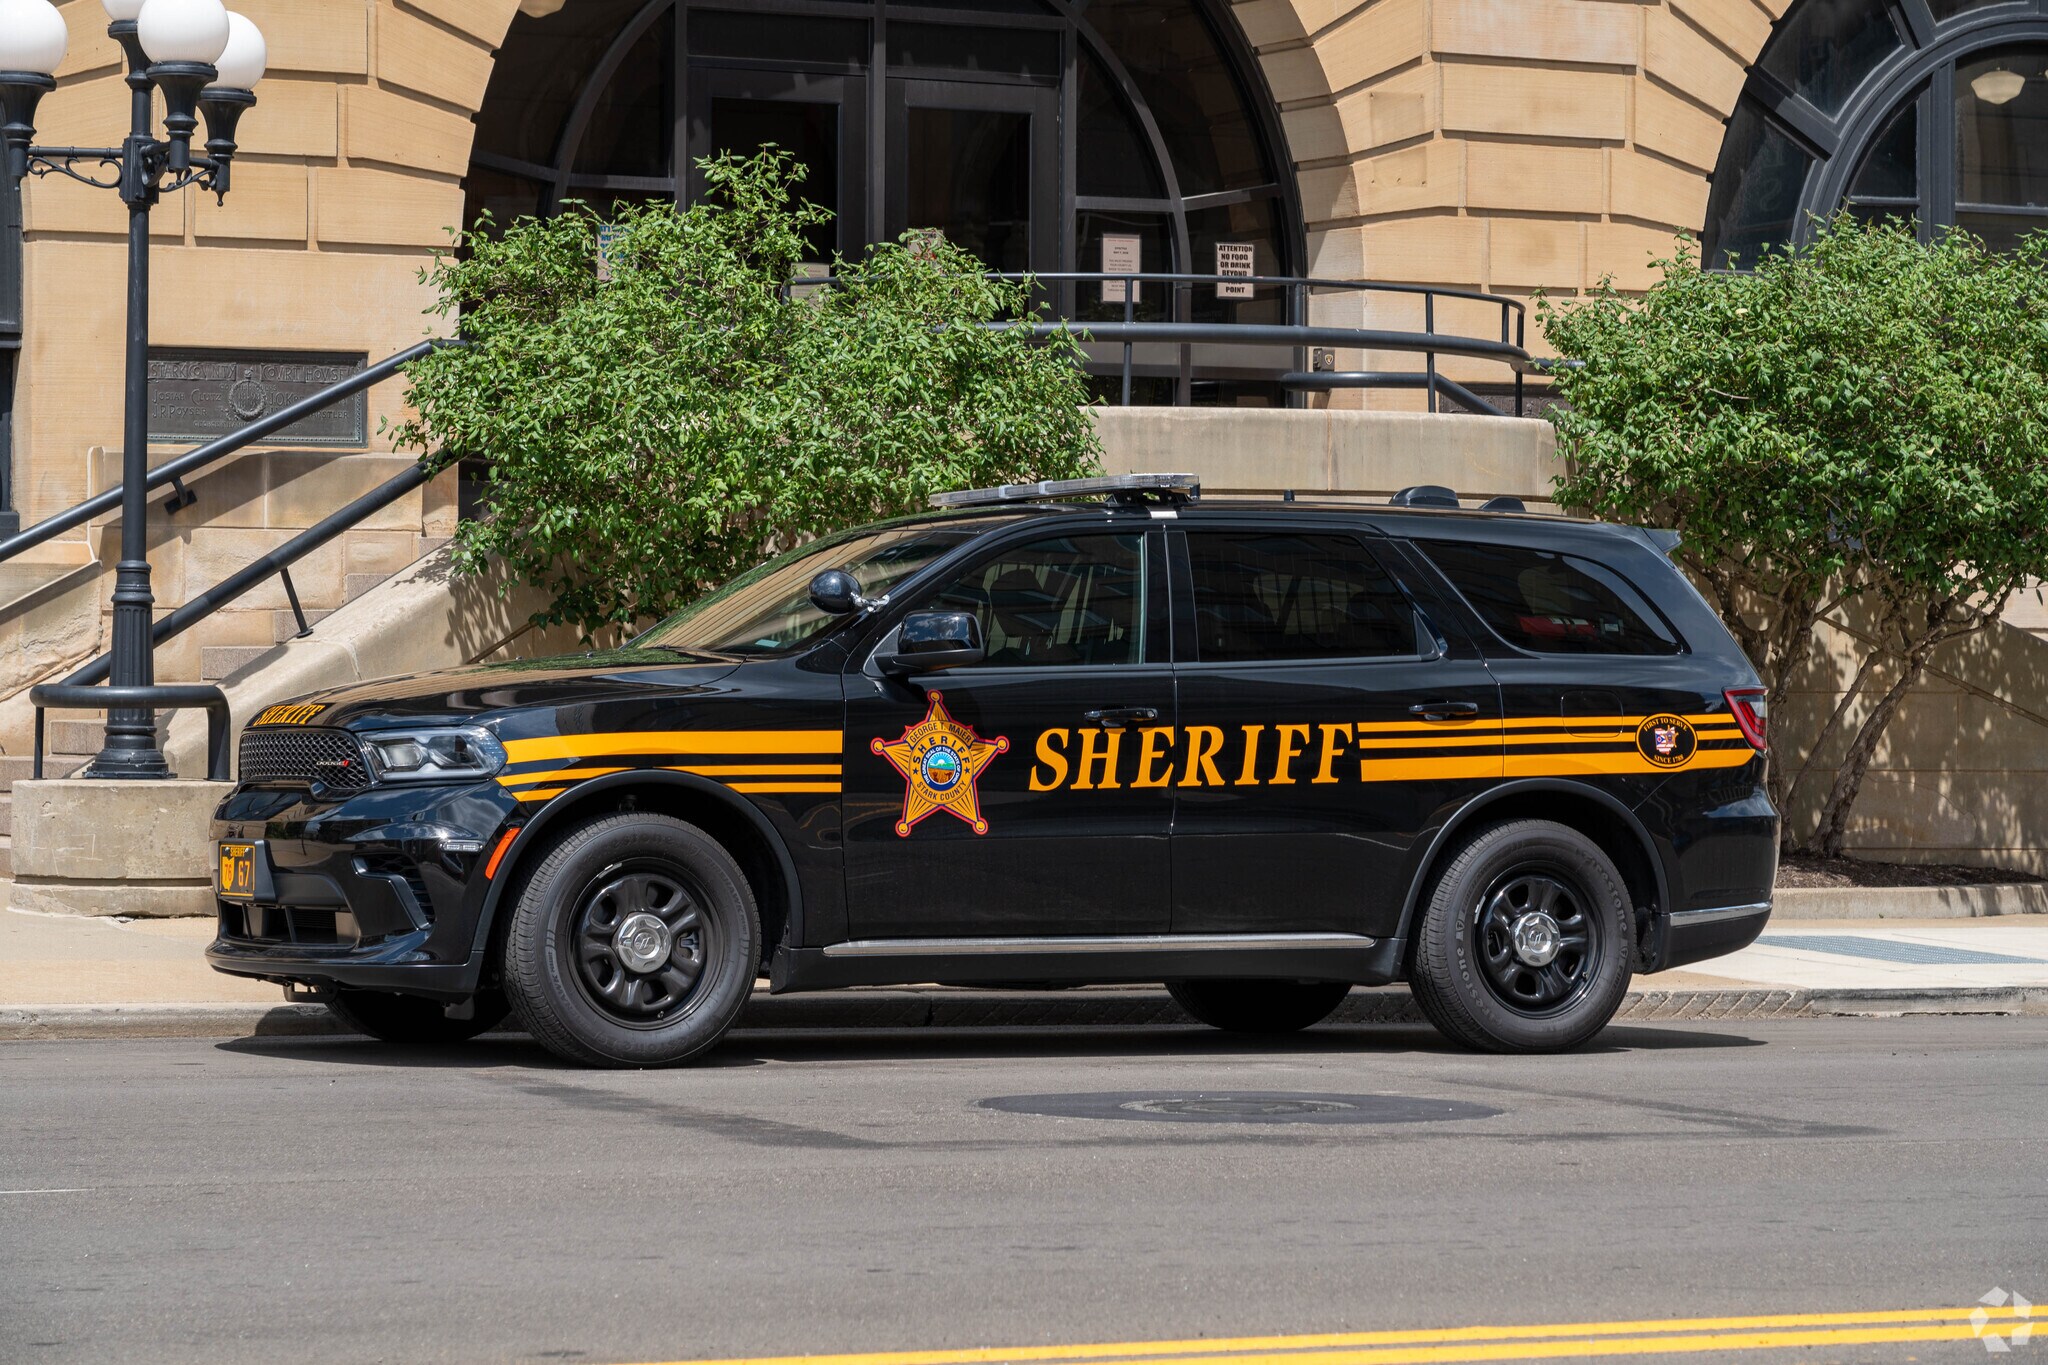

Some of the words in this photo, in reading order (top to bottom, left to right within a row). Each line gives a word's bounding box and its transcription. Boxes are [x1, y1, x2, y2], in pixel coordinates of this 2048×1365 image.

[253, 704, 326, 726] SHERIFF
[1643, 718, 1659, 732] FIRST
[1669, 718, 1688, 732] SERVE
[909, 722, 939, 743] GEORGE
[940, 722, 946, 730] T.
[948, 723, 972, 743] MAIER
[912, 735, 971, 765] SHERIFF
[1028, 722, 1353, 792] SHERIFF
[1654, 755, 1671, 763] SINCE
[916, 781, 938, 801] STARK
[940, 780, 967, 801] COUNTY
[225, 863, 232, 881] 76
[238, 860, 251, 887] 67
